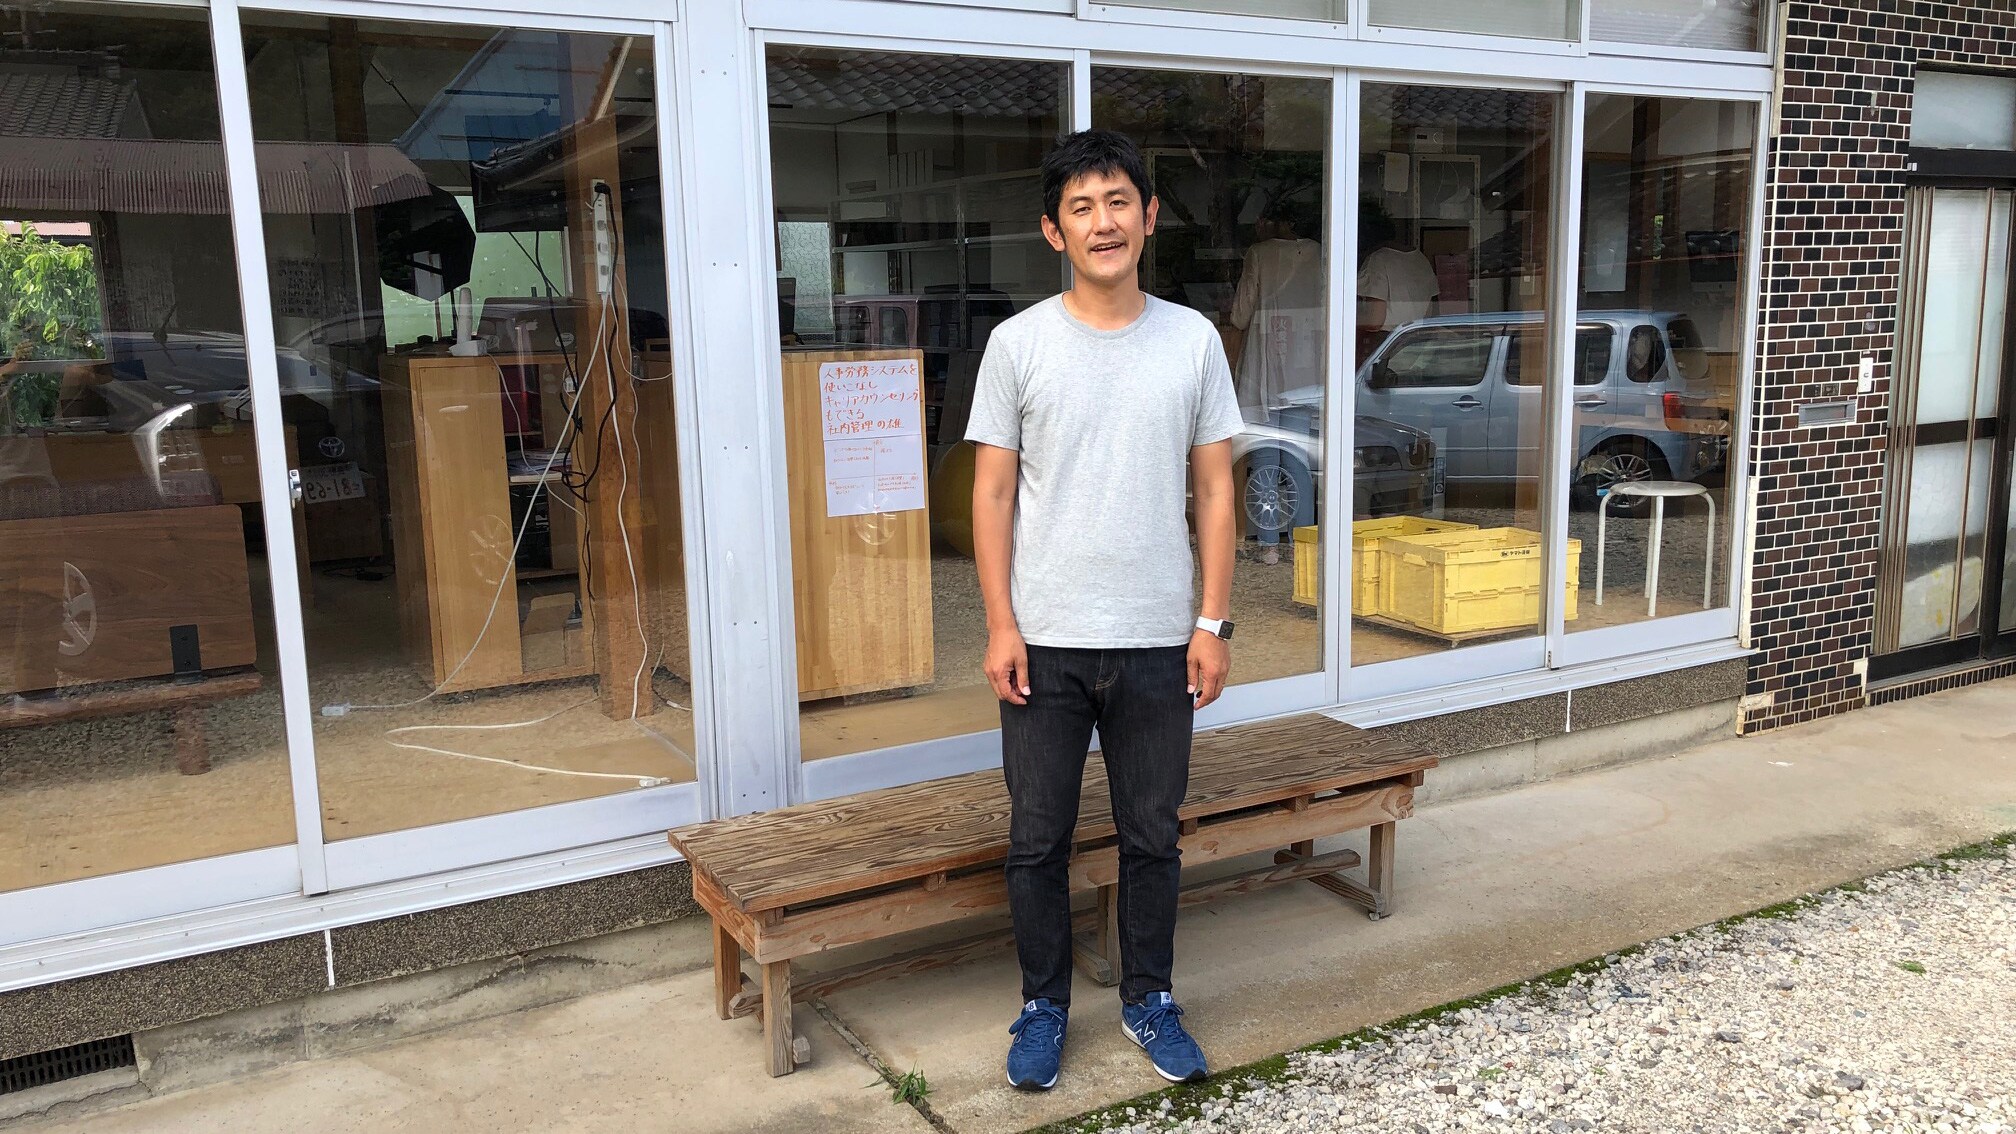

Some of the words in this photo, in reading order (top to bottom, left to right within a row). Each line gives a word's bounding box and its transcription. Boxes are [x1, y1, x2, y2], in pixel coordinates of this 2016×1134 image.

[824, 364, 917, 379] 人事労務システムを
[824, 381, 878, 393] 使いこなし
[824, 389, 919, 407] キャリアカウンセリング
[826, 409, 865, 421] もできる
